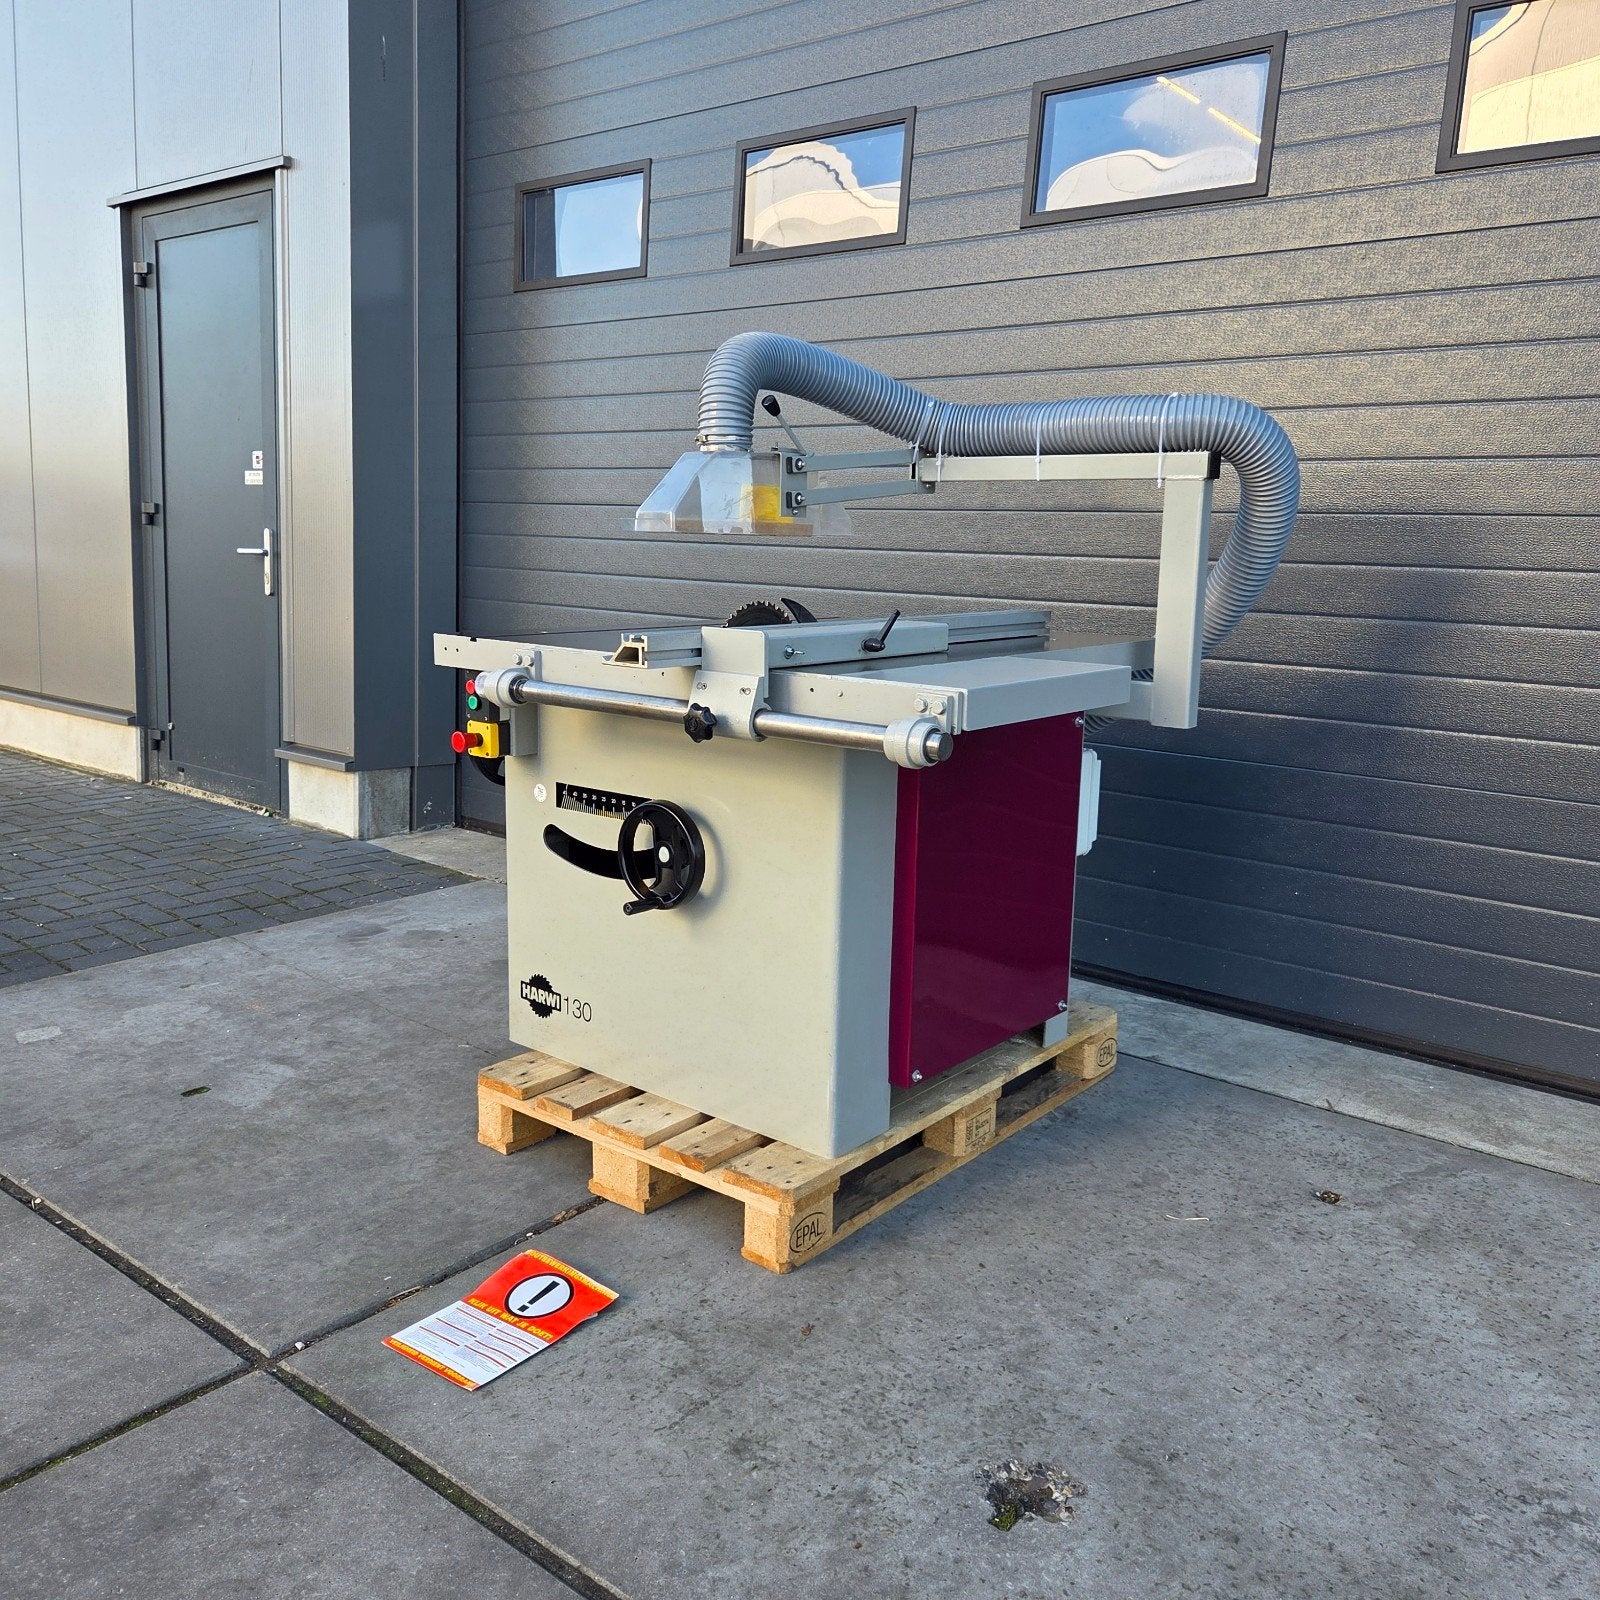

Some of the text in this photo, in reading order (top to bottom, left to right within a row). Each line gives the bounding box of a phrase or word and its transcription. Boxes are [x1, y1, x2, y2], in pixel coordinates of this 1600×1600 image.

[522, 983, 592, 1023] HARWI 130
[1099, 1043, 1115, 1063] EPAL
[796, 1218, 823, 1248] EPAL
[467, 1297, 488, 1309] KIJK
[486, 1306, 502, 1315] UIT
[499, 1312, 520, 1323] WAT
[516, 1321, 529, 1329] JE
